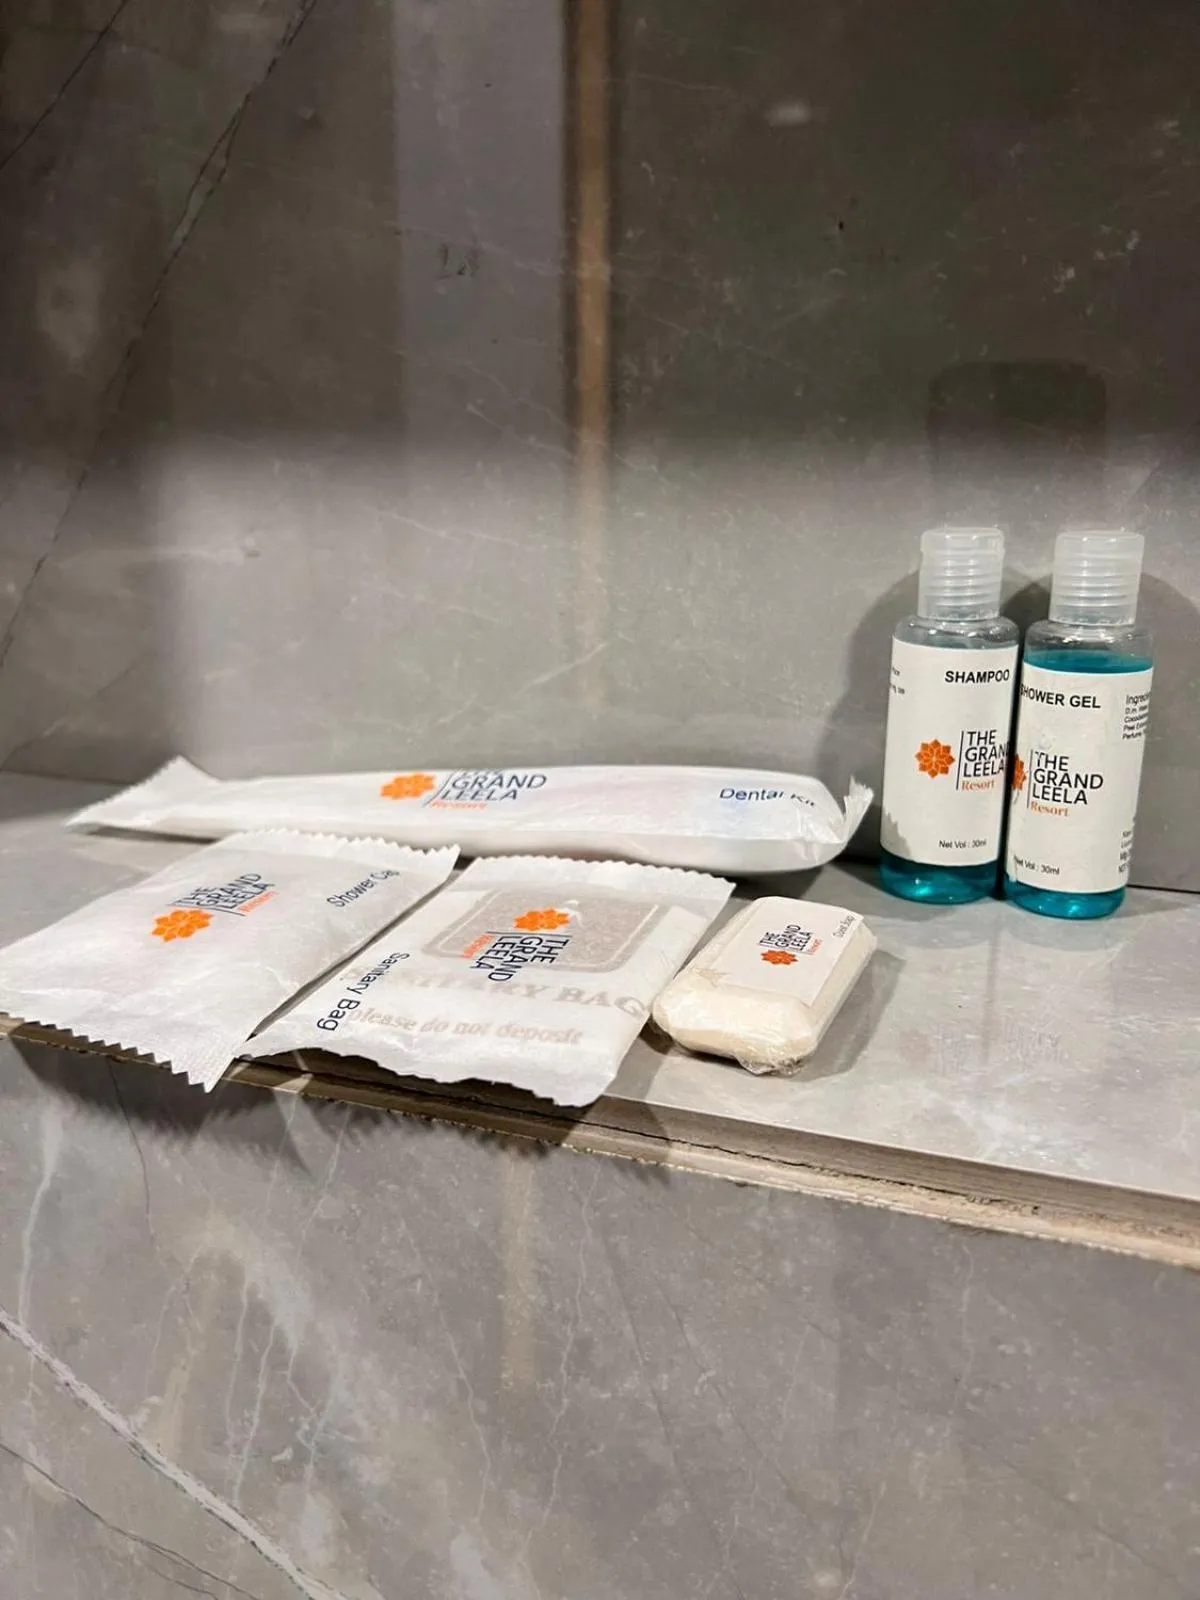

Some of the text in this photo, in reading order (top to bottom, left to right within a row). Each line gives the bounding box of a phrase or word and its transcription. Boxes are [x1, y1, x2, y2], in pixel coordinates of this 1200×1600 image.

[944, 669, 1010, 683] SHAMPOO
[1069, 694, 1101, 709] GEL
[967, 729, 997, 746] THE
[965, 742, 1010, 762] GRAN
[1034, 751, 1070, 772] THE
[963, 759, 1006, 778] LEELA
[451, 773, 548, 790] GRAND
[961, 779, 995, 792] Resort
[1032, 768, 1104, 790] GRAND
[1031, 783, 1088, 805] LEELA
[1030, 801, 1069, 817] Resort
[938, 840, 953, 849] Net
[954, 838, 967, 849] Vol
[172, 887, 218, 905] THE
[195, 873, 262, 907] GRAND
[326, 879, 376, 908] Shower
[469, 935, 522, 970] LEELA
[487, 936, 543, 982] GRAND
[530, 938, 570, 964] THE
[316, 952, 410, 1031] Sanitary Bag
[553, 985, 647, 1018] BAG
